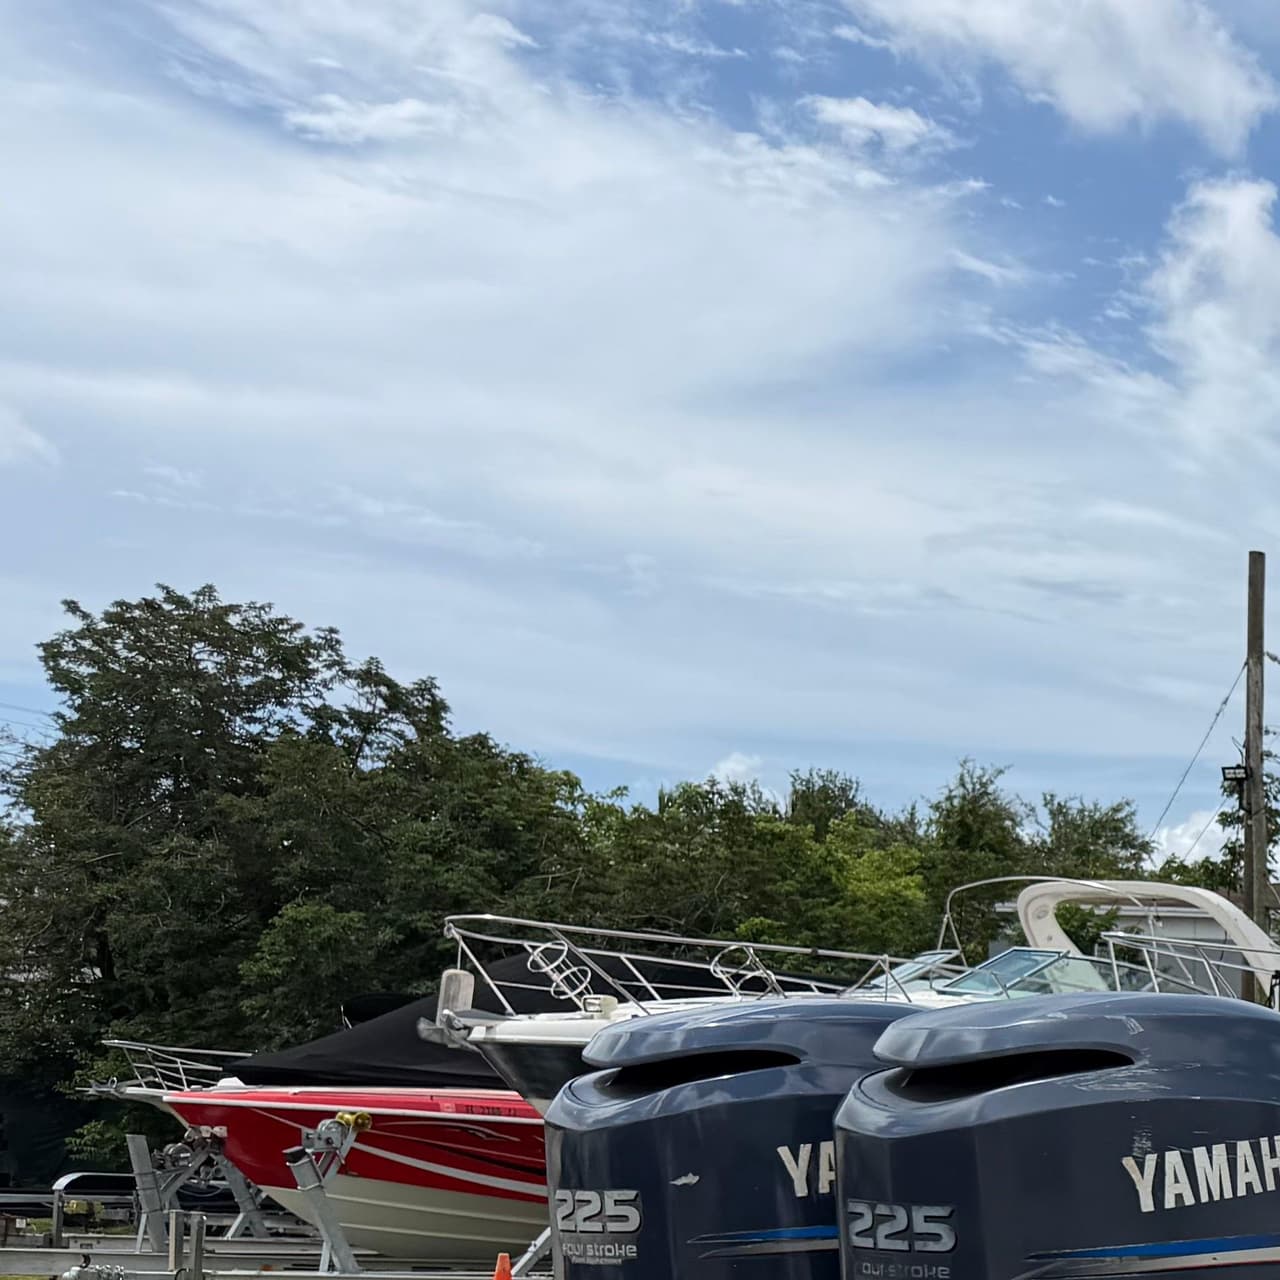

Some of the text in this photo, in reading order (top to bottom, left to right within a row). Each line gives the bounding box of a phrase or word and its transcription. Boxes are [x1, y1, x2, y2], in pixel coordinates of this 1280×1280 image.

[555, 1189, 642, 1234] 225
[847, 1202, 958, 1253] 225
[586, 1243, 637, 1256] stroke
[859, 1262, 885, 1277] our
